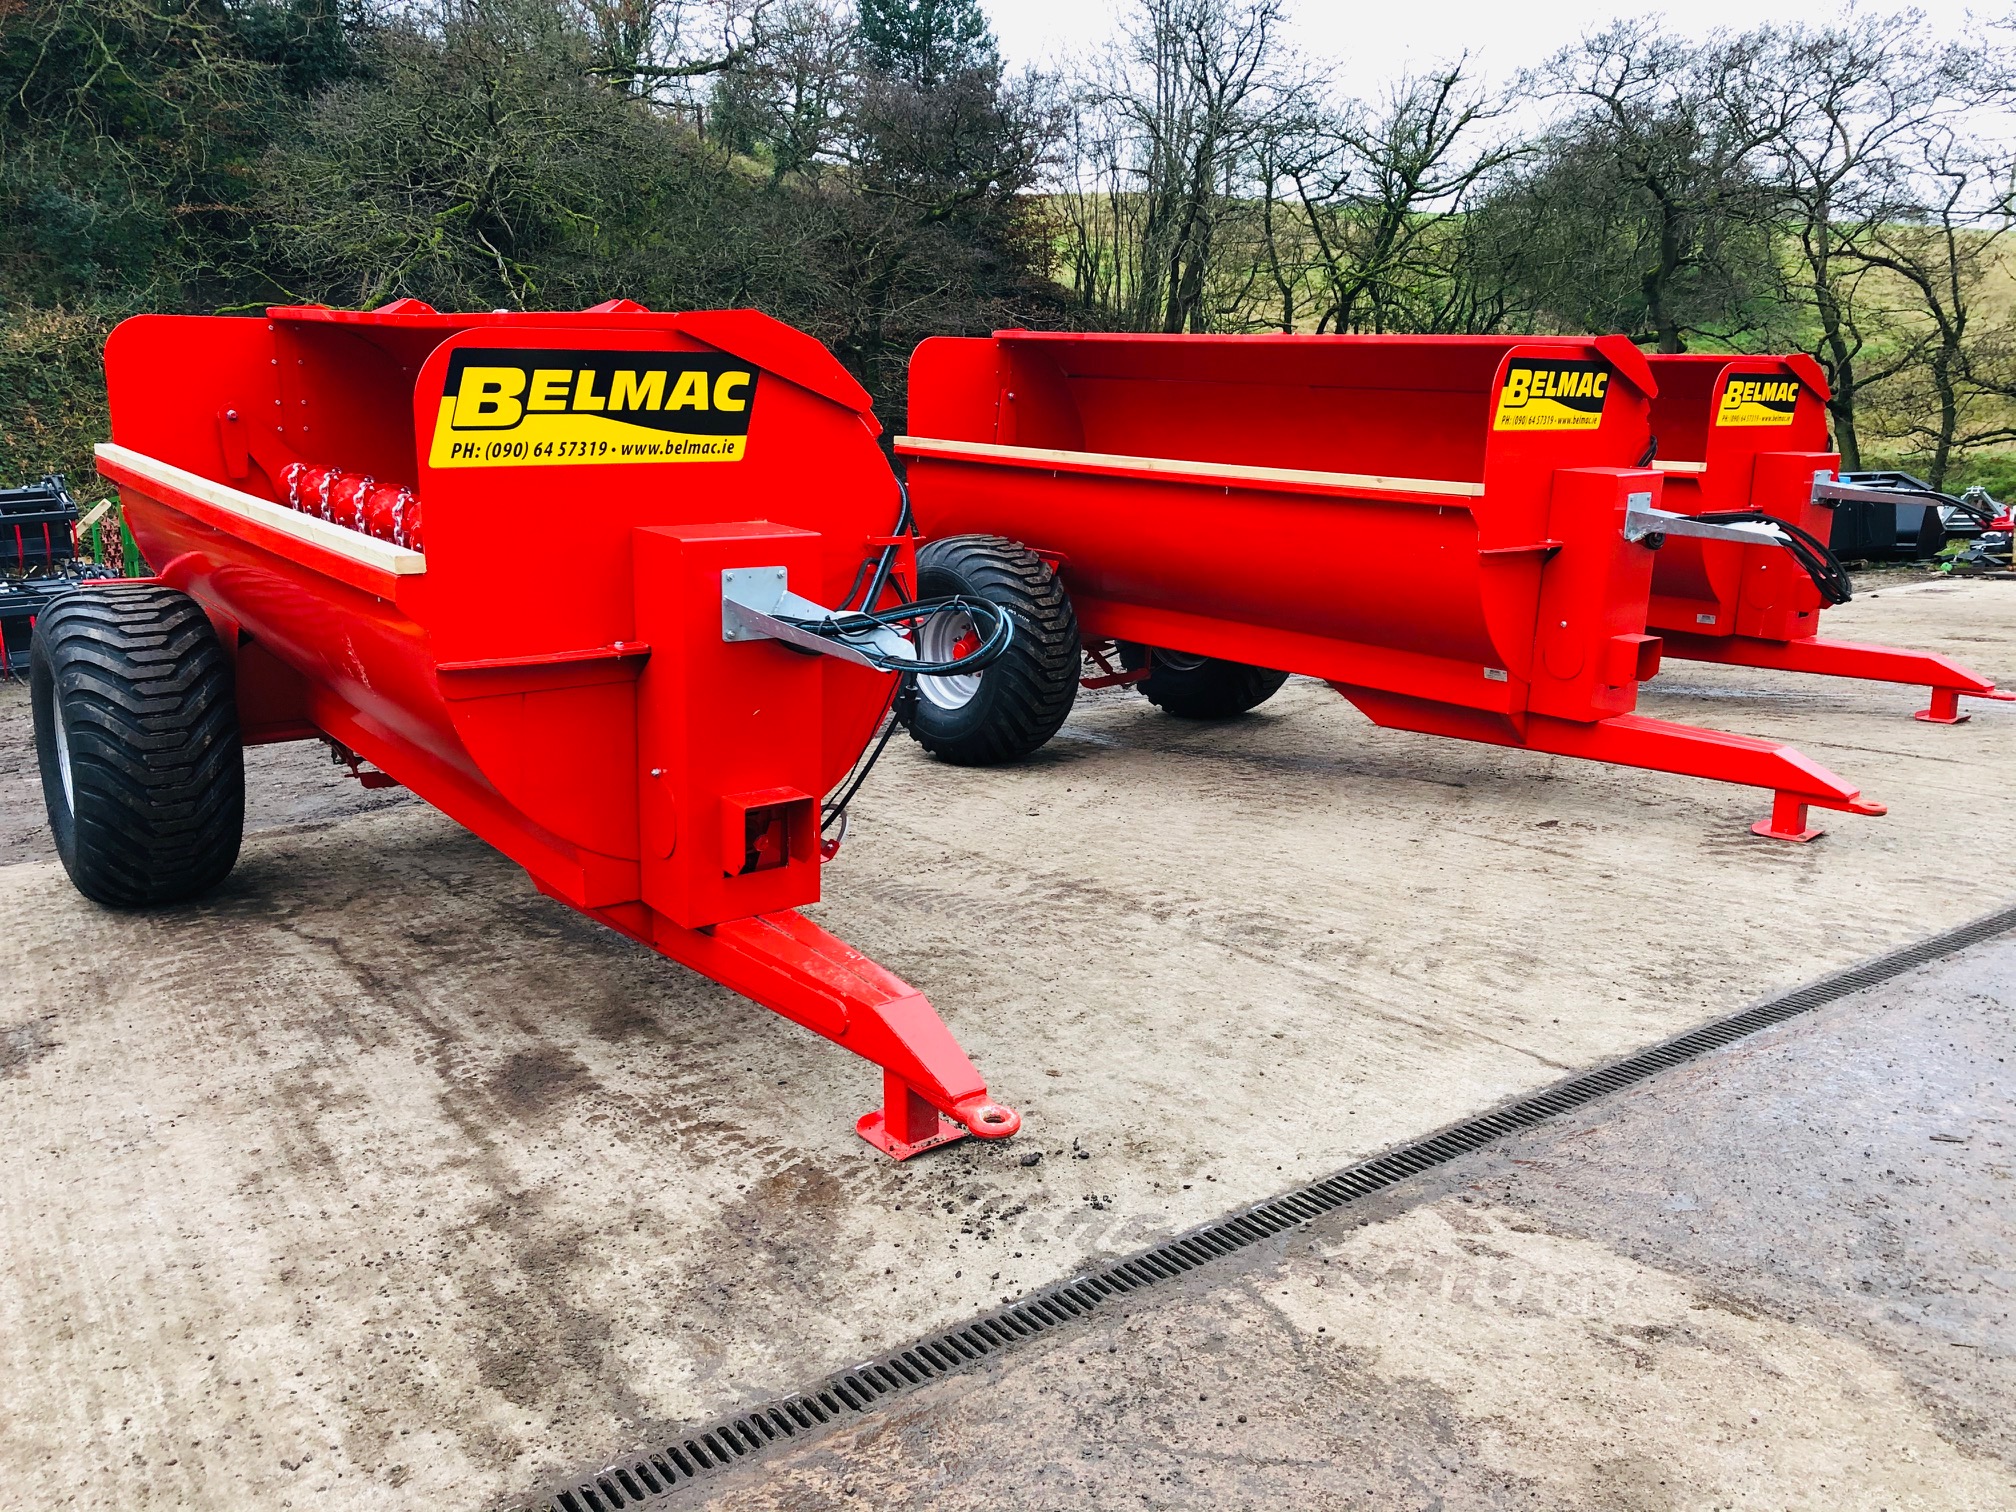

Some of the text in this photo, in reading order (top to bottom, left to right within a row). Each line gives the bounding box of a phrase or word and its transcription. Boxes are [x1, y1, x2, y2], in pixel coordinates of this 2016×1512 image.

[451, 367, 750, 429] BELMAC
[1504, 369, 1608, 407] BELMAC
[1724, 381, 1799, 409] BELMAC
[1557, 415, 1598, 425] www.belmac.ie
[451, 438, 735, 460] PH: (090) 64 57319 www.belmac.ie
